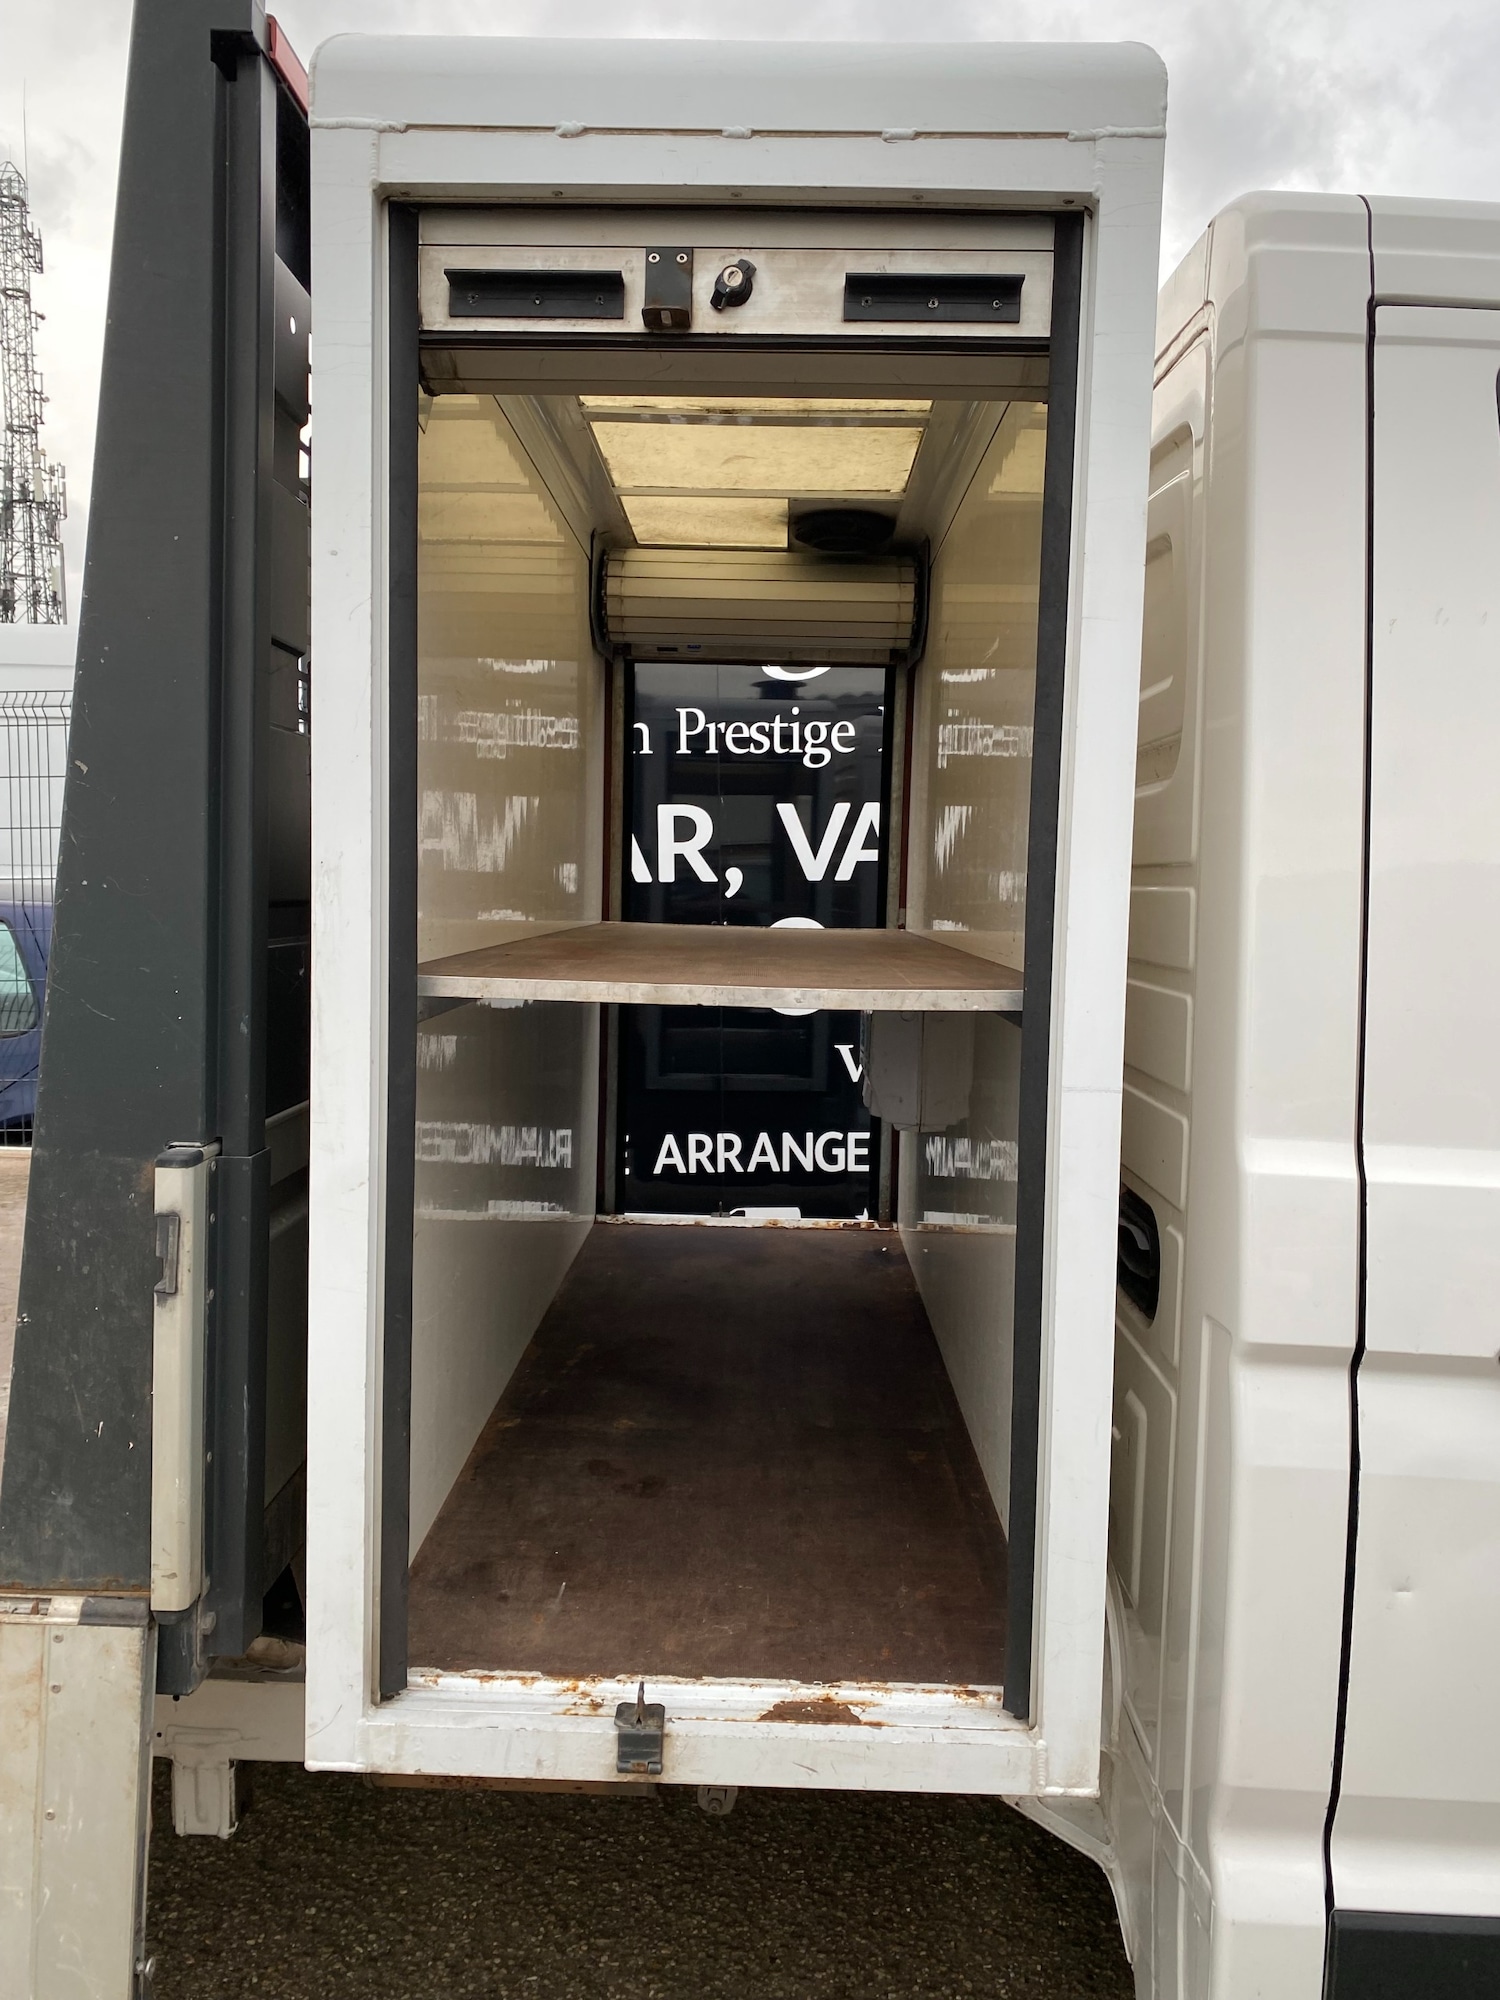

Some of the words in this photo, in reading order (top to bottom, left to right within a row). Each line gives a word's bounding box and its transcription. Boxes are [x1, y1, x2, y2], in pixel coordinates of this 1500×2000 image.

[676, 707, 855, 768] Prestige
[632, 804, 743, 898] R,
[653, 1132, 870, 1174] ARRANGE
